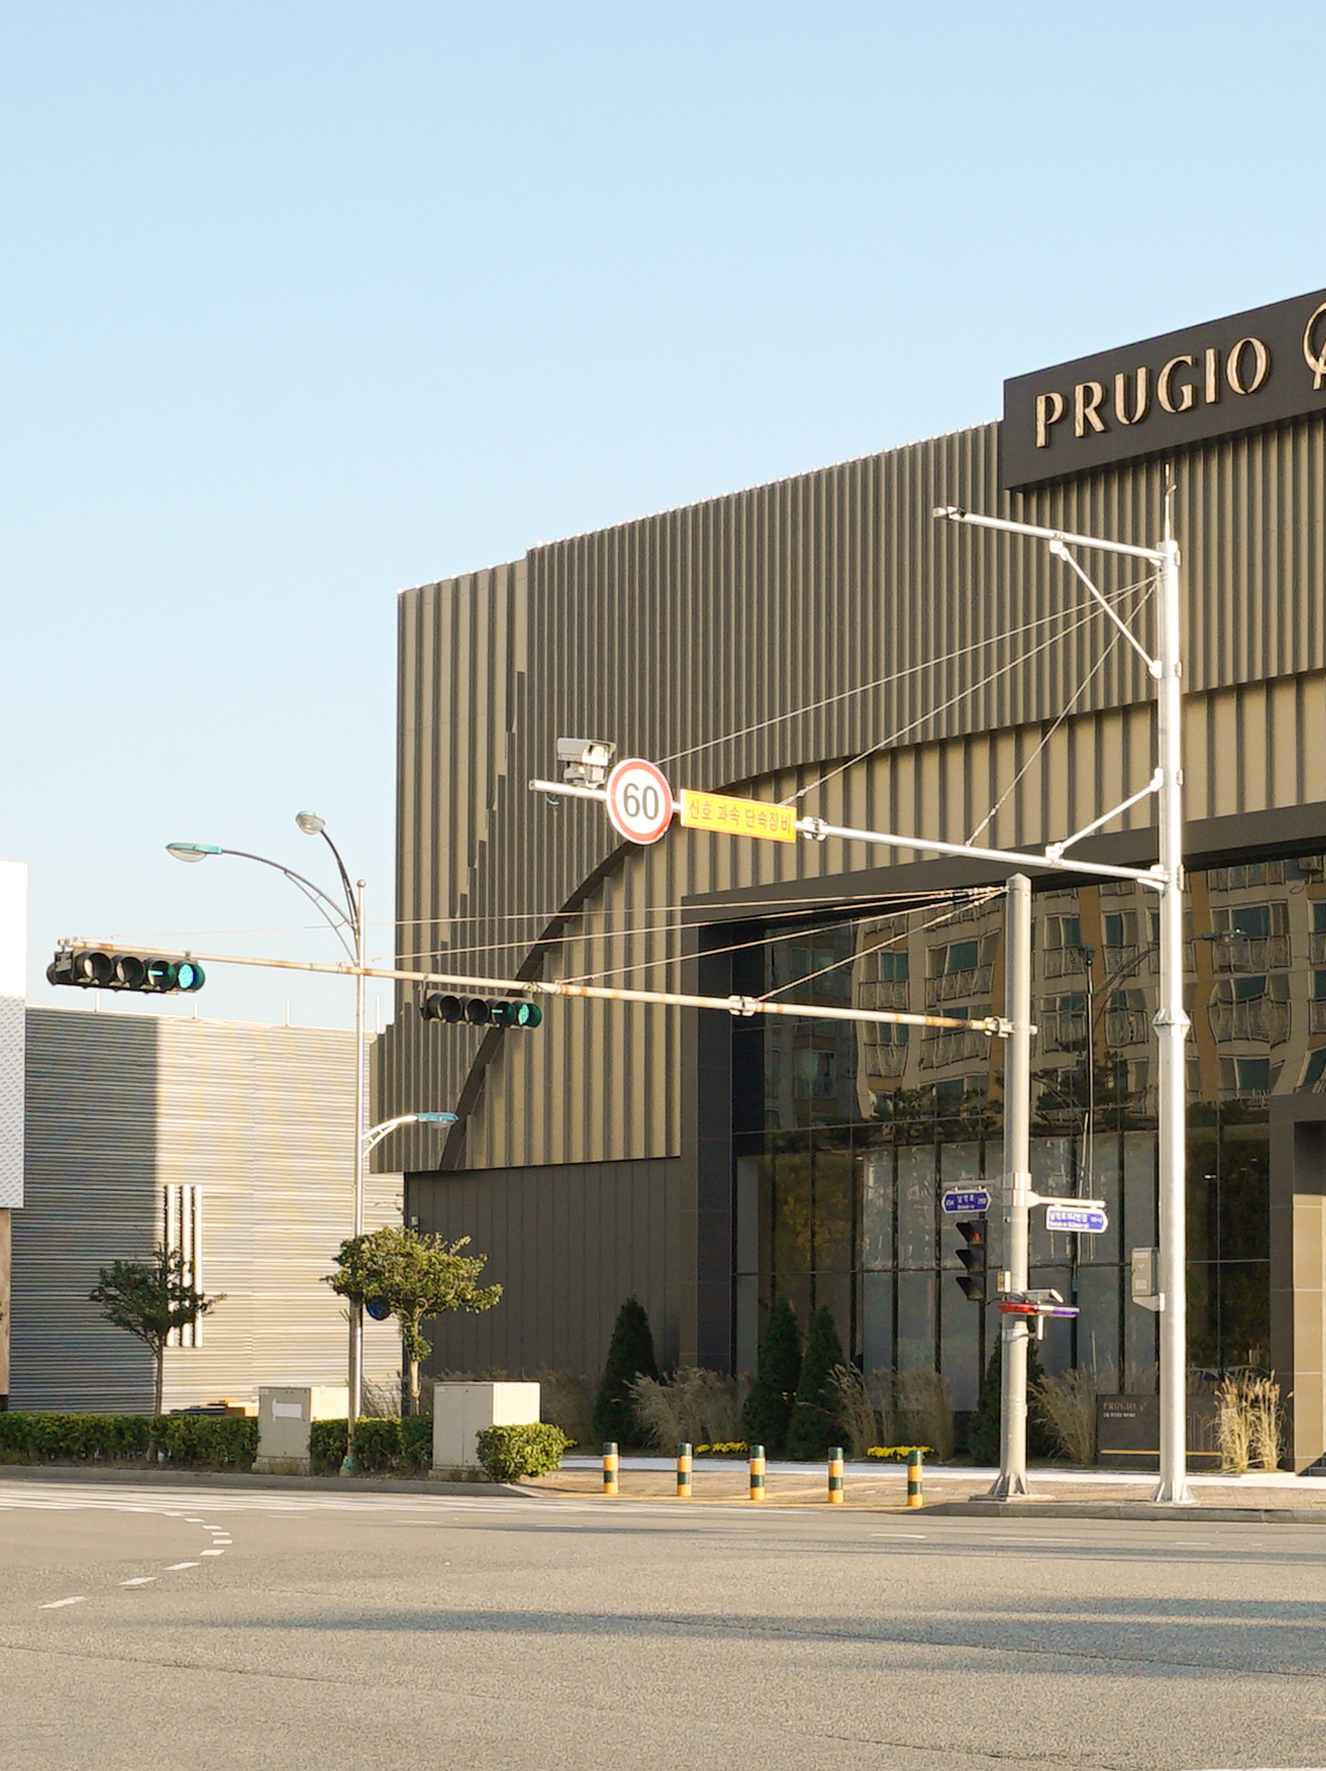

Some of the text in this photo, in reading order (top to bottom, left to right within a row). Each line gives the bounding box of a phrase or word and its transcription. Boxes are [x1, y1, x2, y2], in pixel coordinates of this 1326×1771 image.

[1034, 337, 1271, 448] PRUGIO
[622, 782, 660, 821] 60
[688, 800, 792, 834] 신호 과속 단속장비
